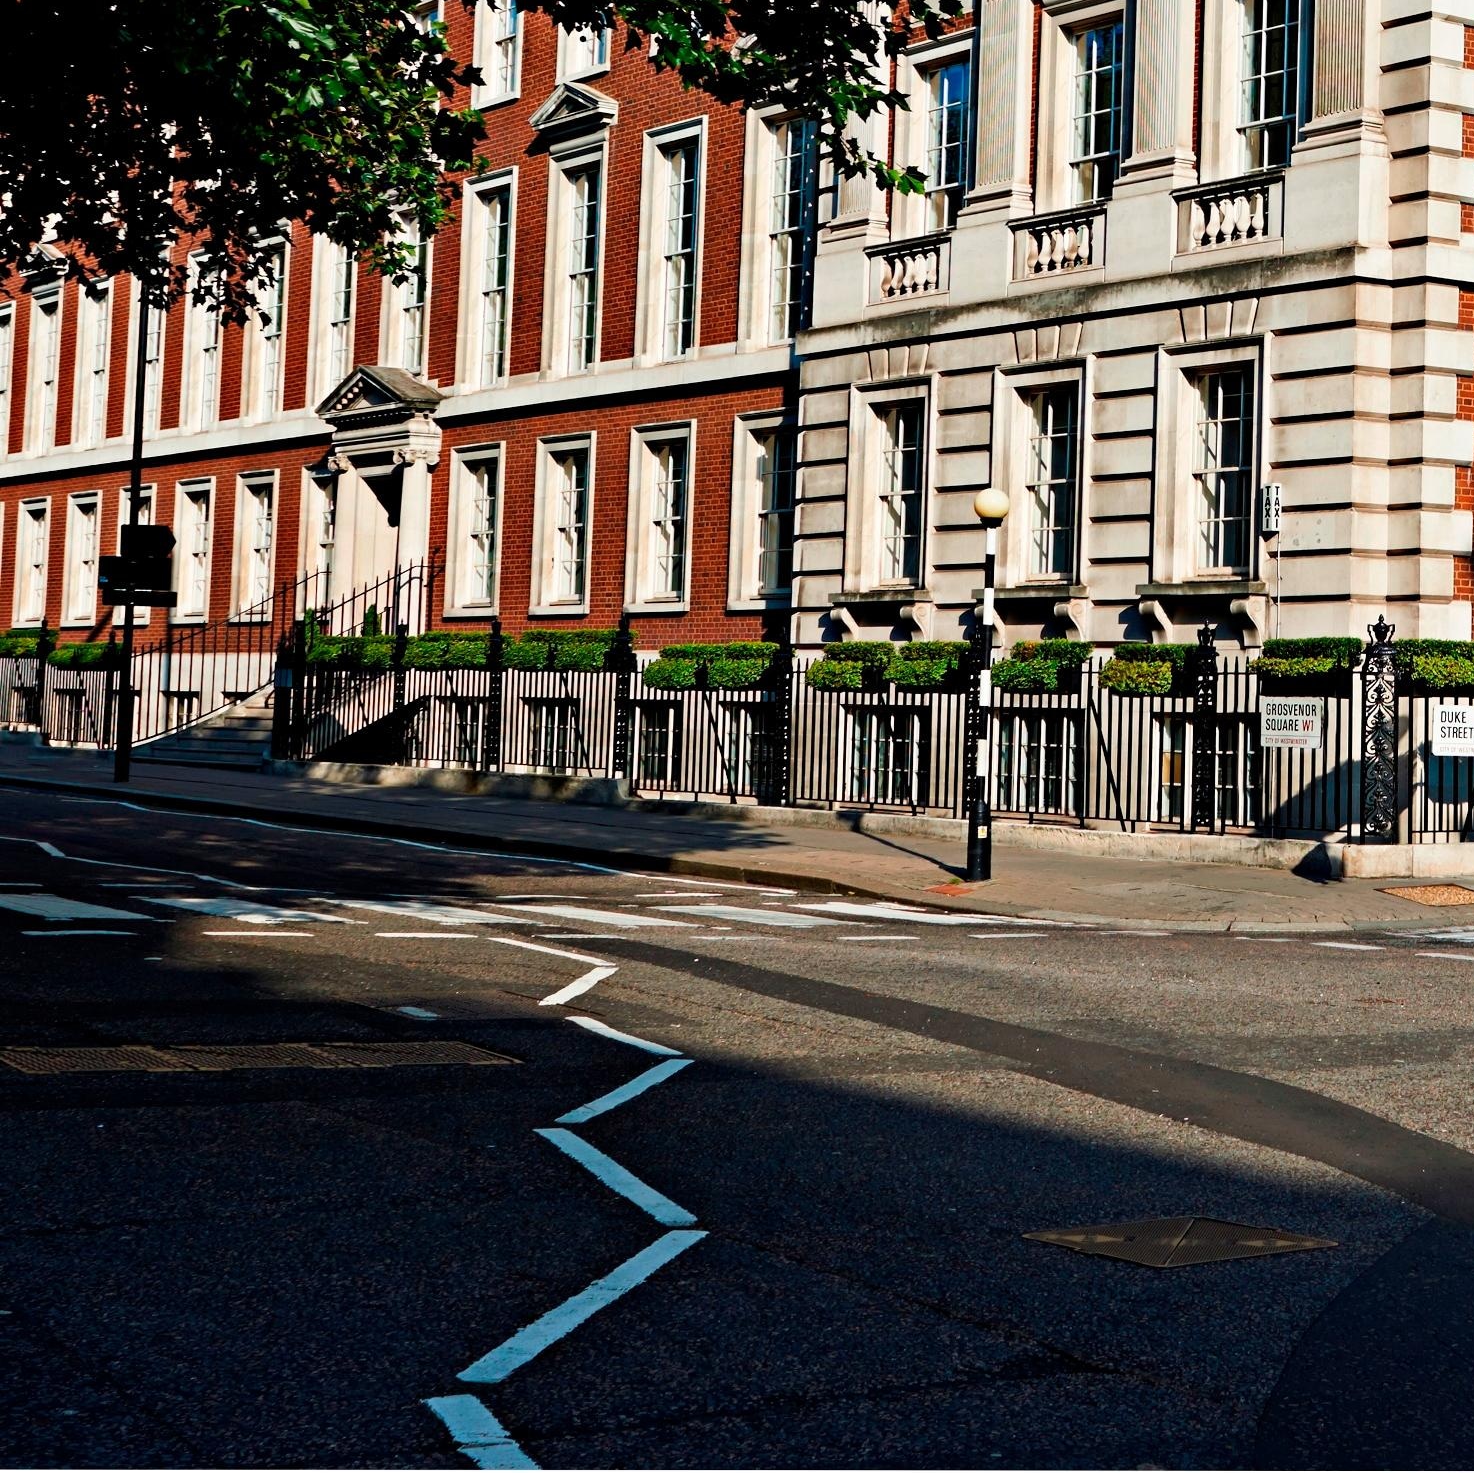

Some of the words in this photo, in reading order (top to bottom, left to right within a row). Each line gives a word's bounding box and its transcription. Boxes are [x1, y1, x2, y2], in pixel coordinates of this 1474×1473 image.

[1266, 702, 1317, 716] GROSVENOR
[1440, 710, 1467, 724] DUKE
[1265, 718, 1299, 731] SQUARE
[1302, 719, 1314, 732] W1
[1440, 726, 1474, 739] STREET
